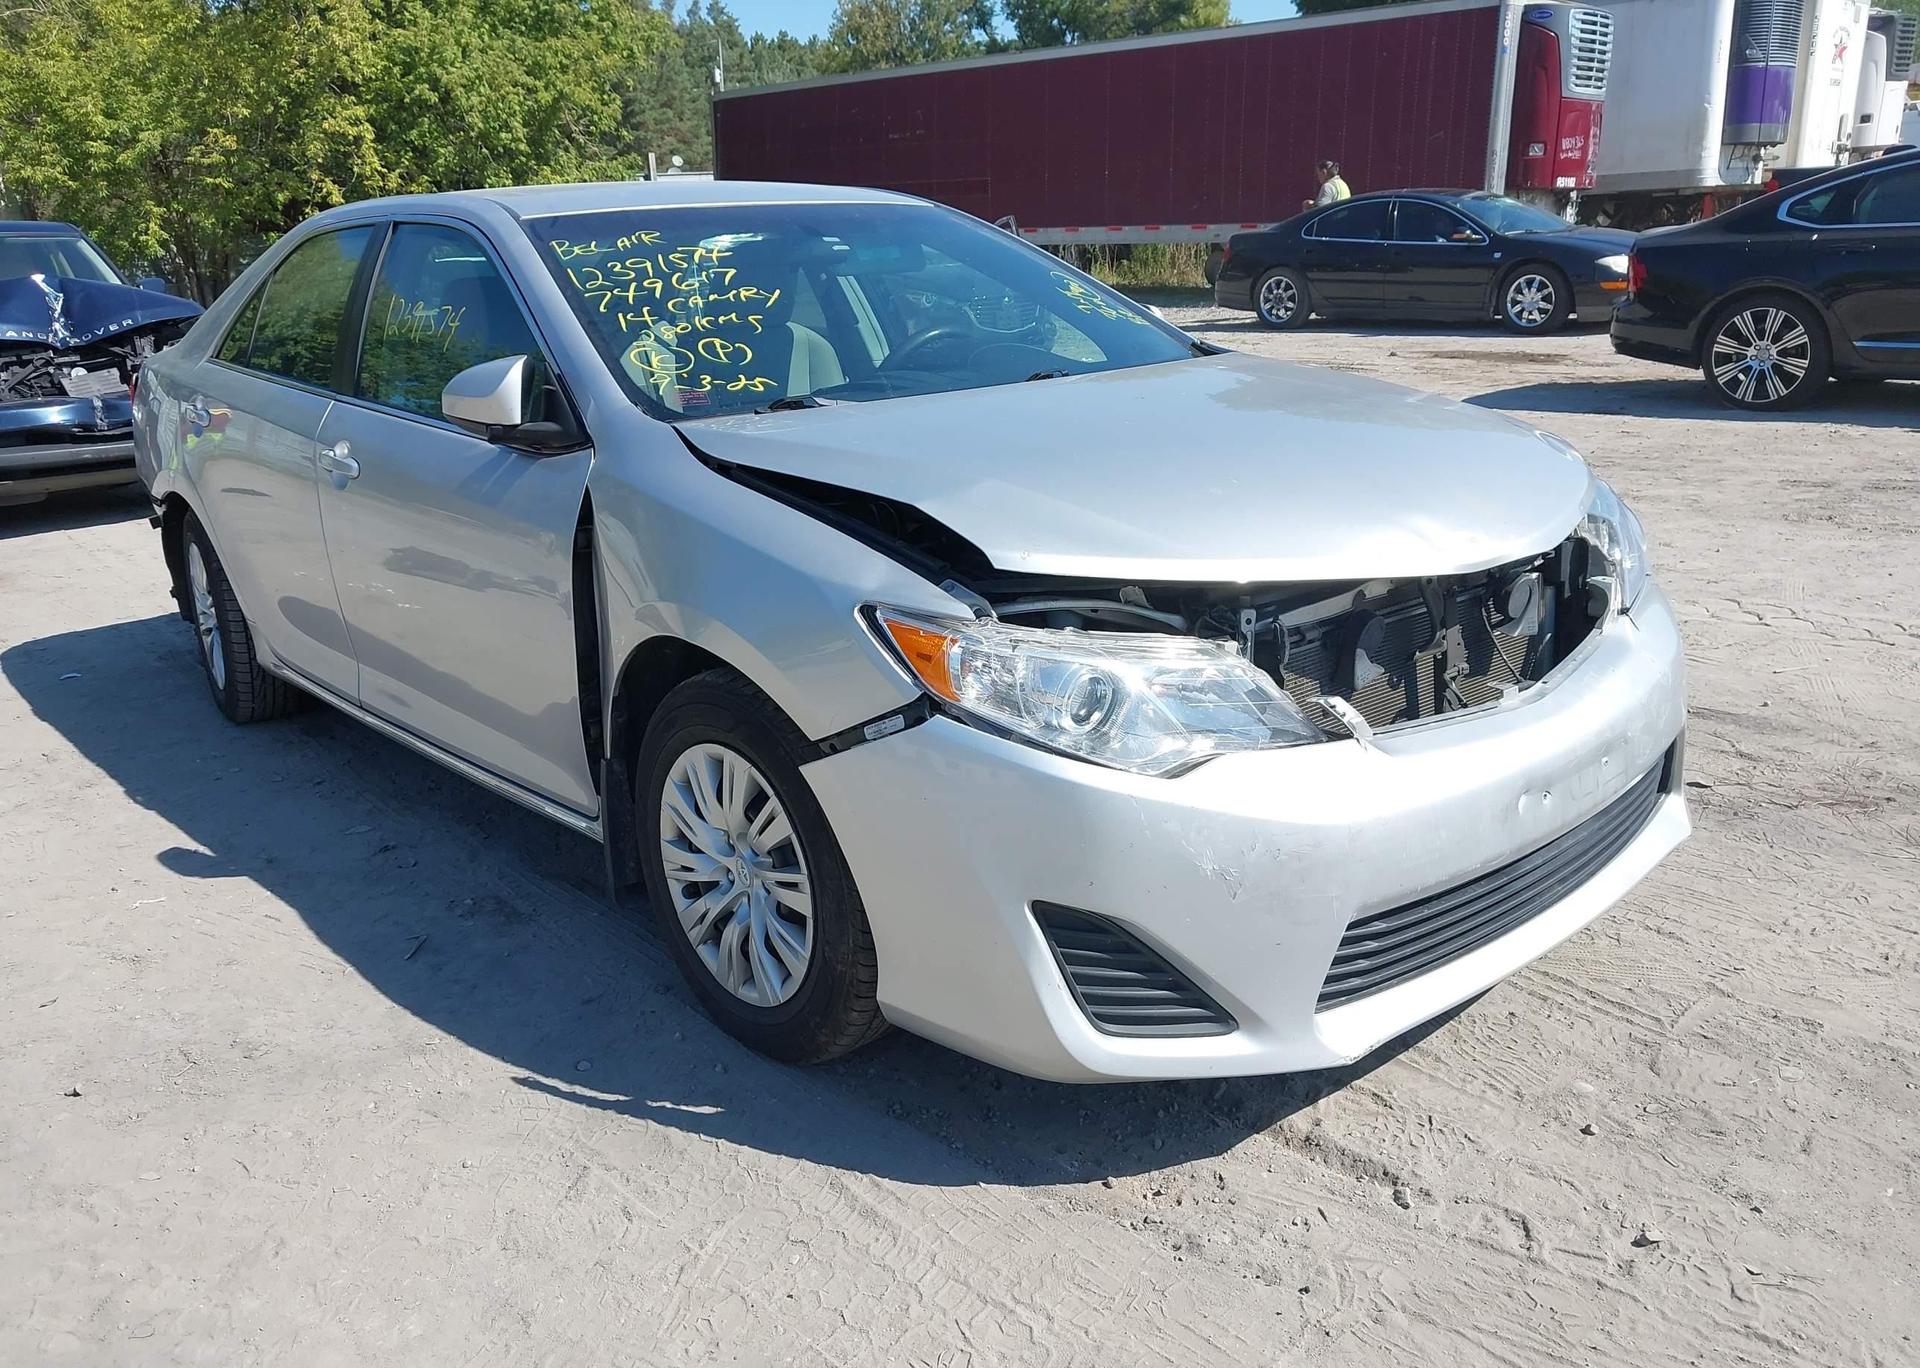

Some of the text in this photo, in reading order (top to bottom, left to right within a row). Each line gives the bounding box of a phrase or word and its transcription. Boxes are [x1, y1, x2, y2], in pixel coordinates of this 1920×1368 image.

[617, 231, 668, 251] AIR
[566, 246, 734, 292] 12391574
[584, 268, 737, 312] 749617
[667, 286, 781, 313] CAMRY
